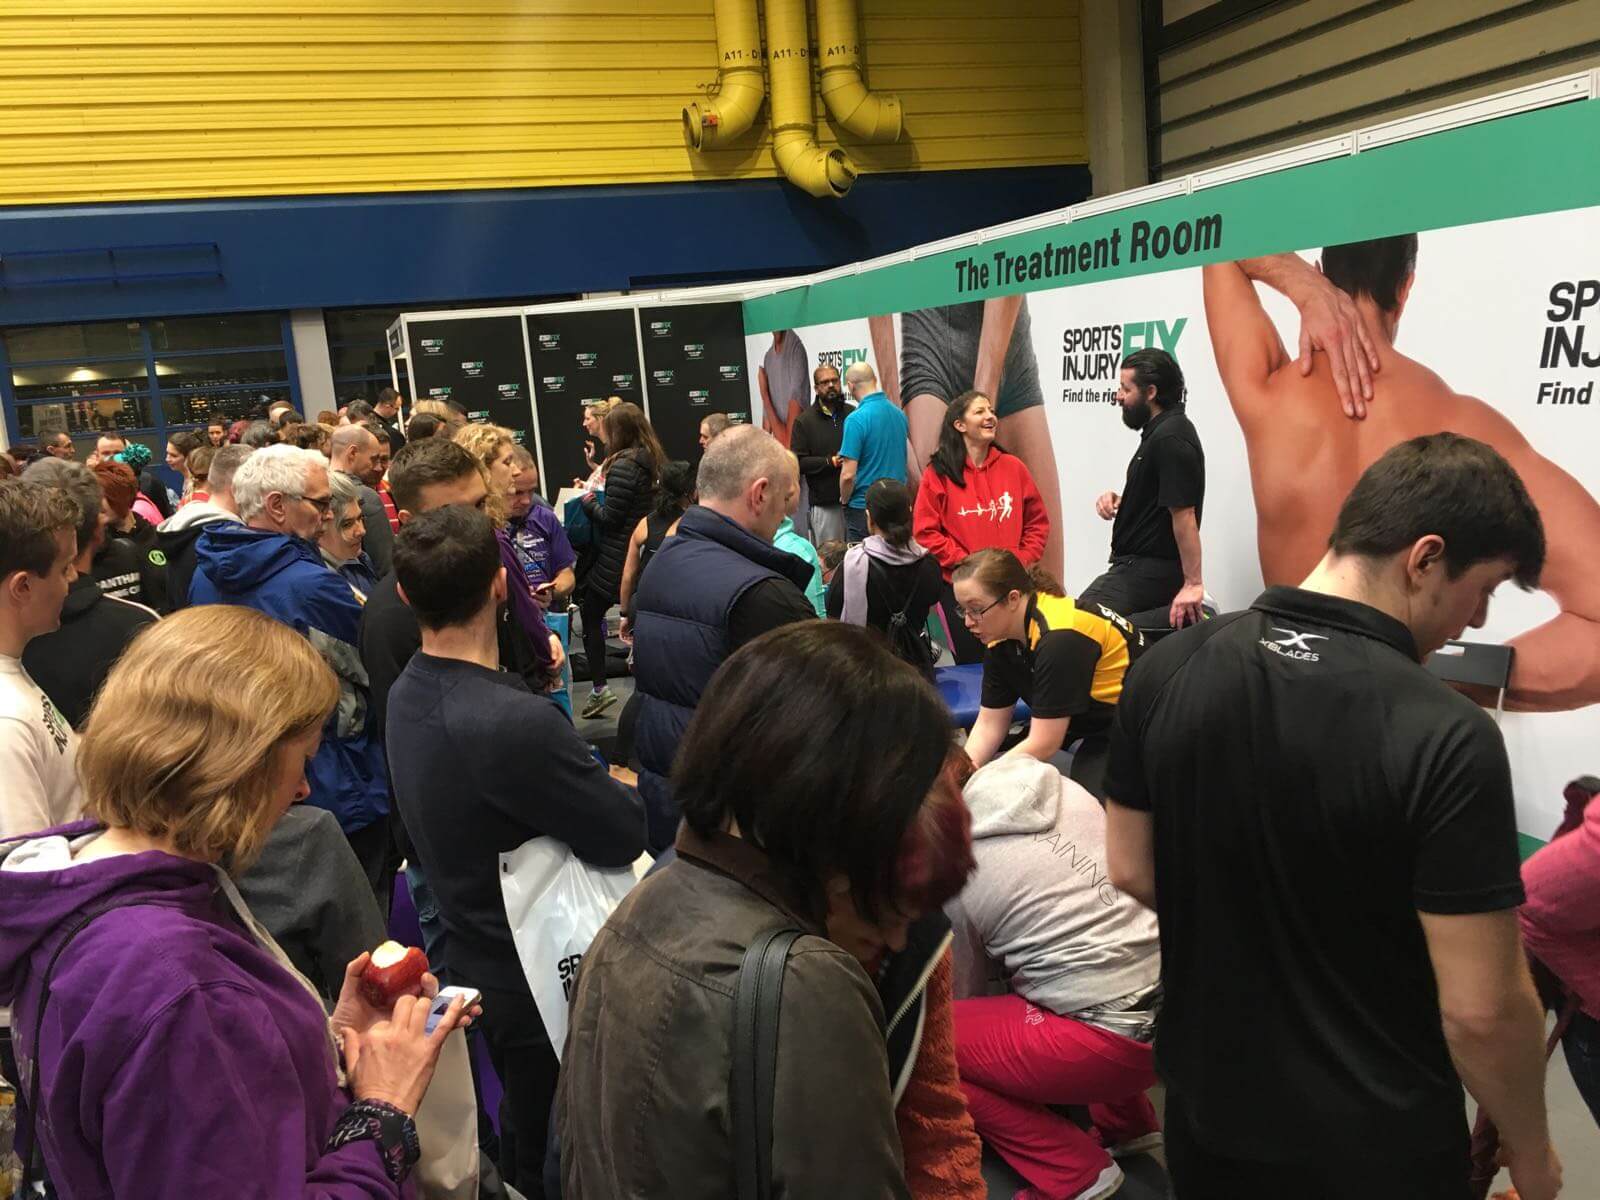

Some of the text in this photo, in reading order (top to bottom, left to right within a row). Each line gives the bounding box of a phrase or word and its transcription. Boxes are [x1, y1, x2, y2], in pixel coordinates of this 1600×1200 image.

[955, 212, 1223, 293] The Treatment Room
[1063, 324, 1122, 353] SPORTS
[1062, 352, 1121, 381] INJURY
[1062, 387, 1121, 406] Find the rig
[1536, 381, 1594, 405] Find
